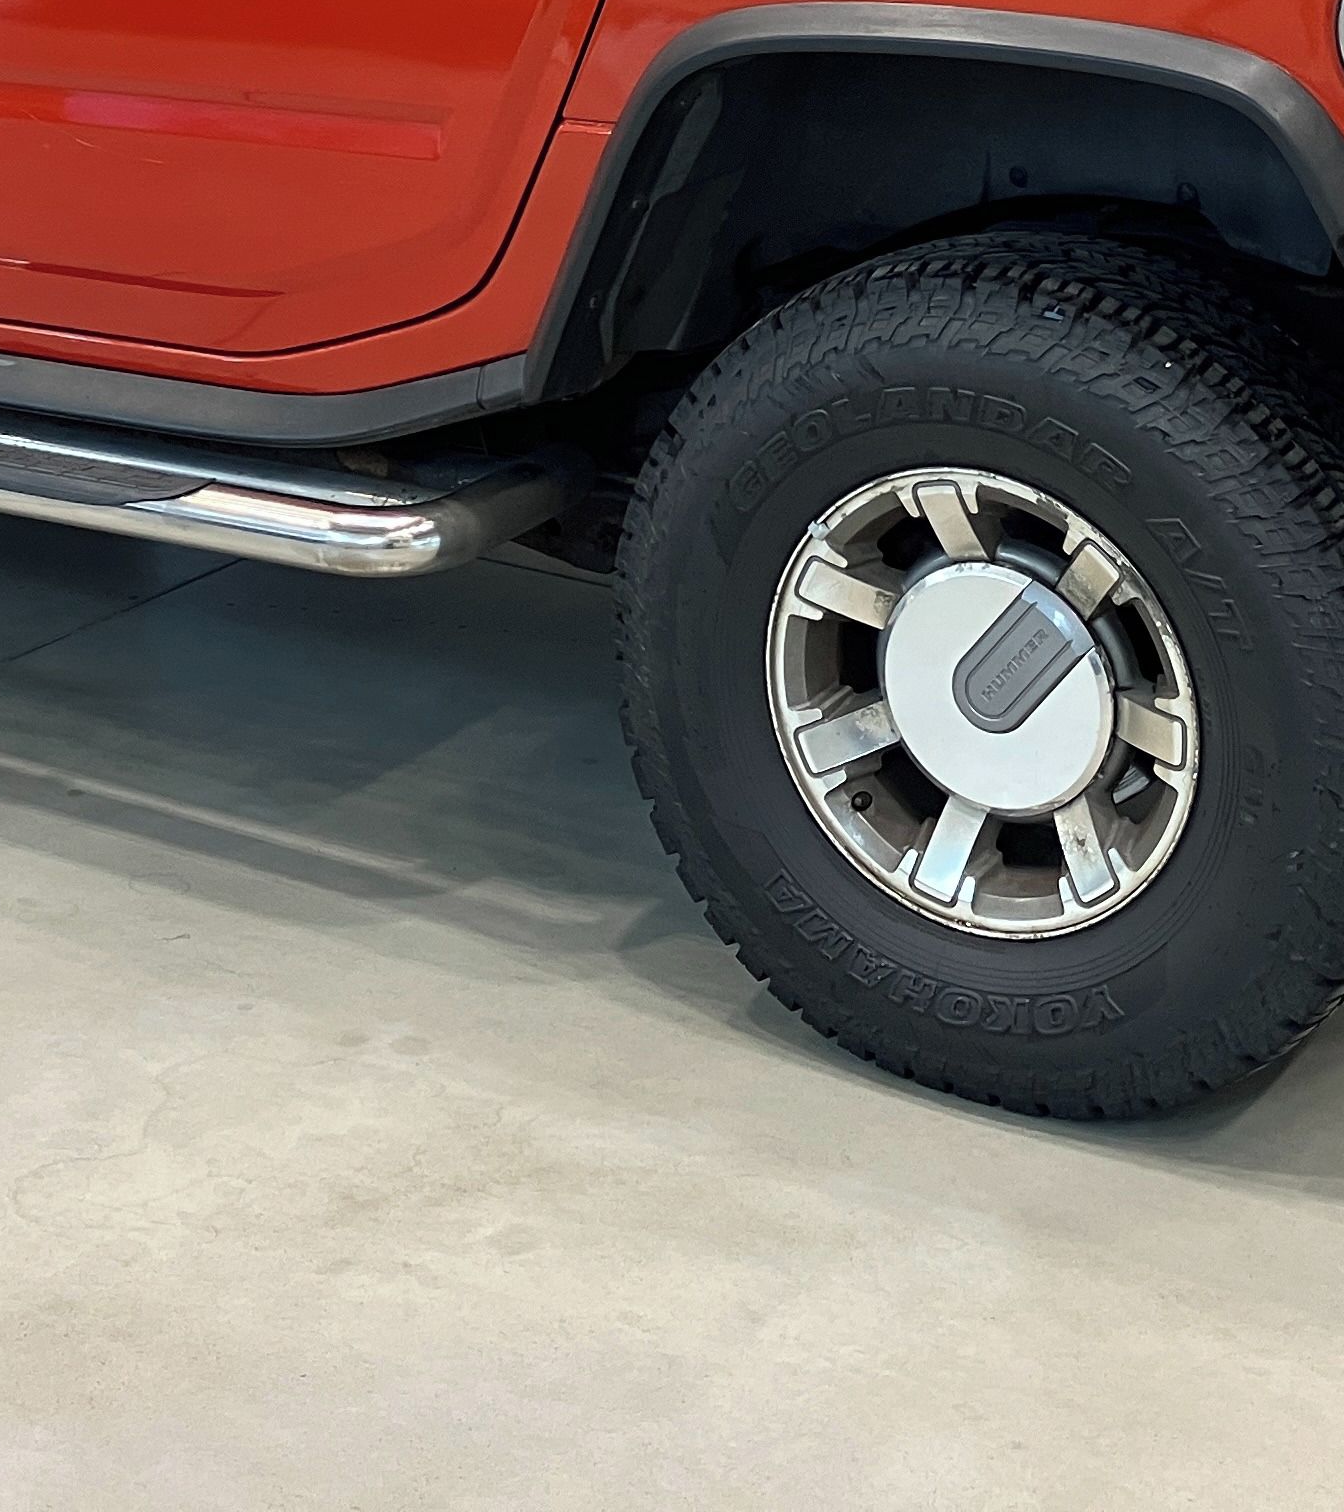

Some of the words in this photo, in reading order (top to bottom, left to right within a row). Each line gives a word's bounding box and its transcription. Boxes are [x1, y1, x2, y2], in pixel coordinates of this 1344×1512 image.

[729, 387, 1133, 512] GEOLANDAR
[1146, 517, 1255, 650] A/T
[981, 629, 1049, 703] HUMMER
[763, 869, 1125, 1035] YOKOHAMA
